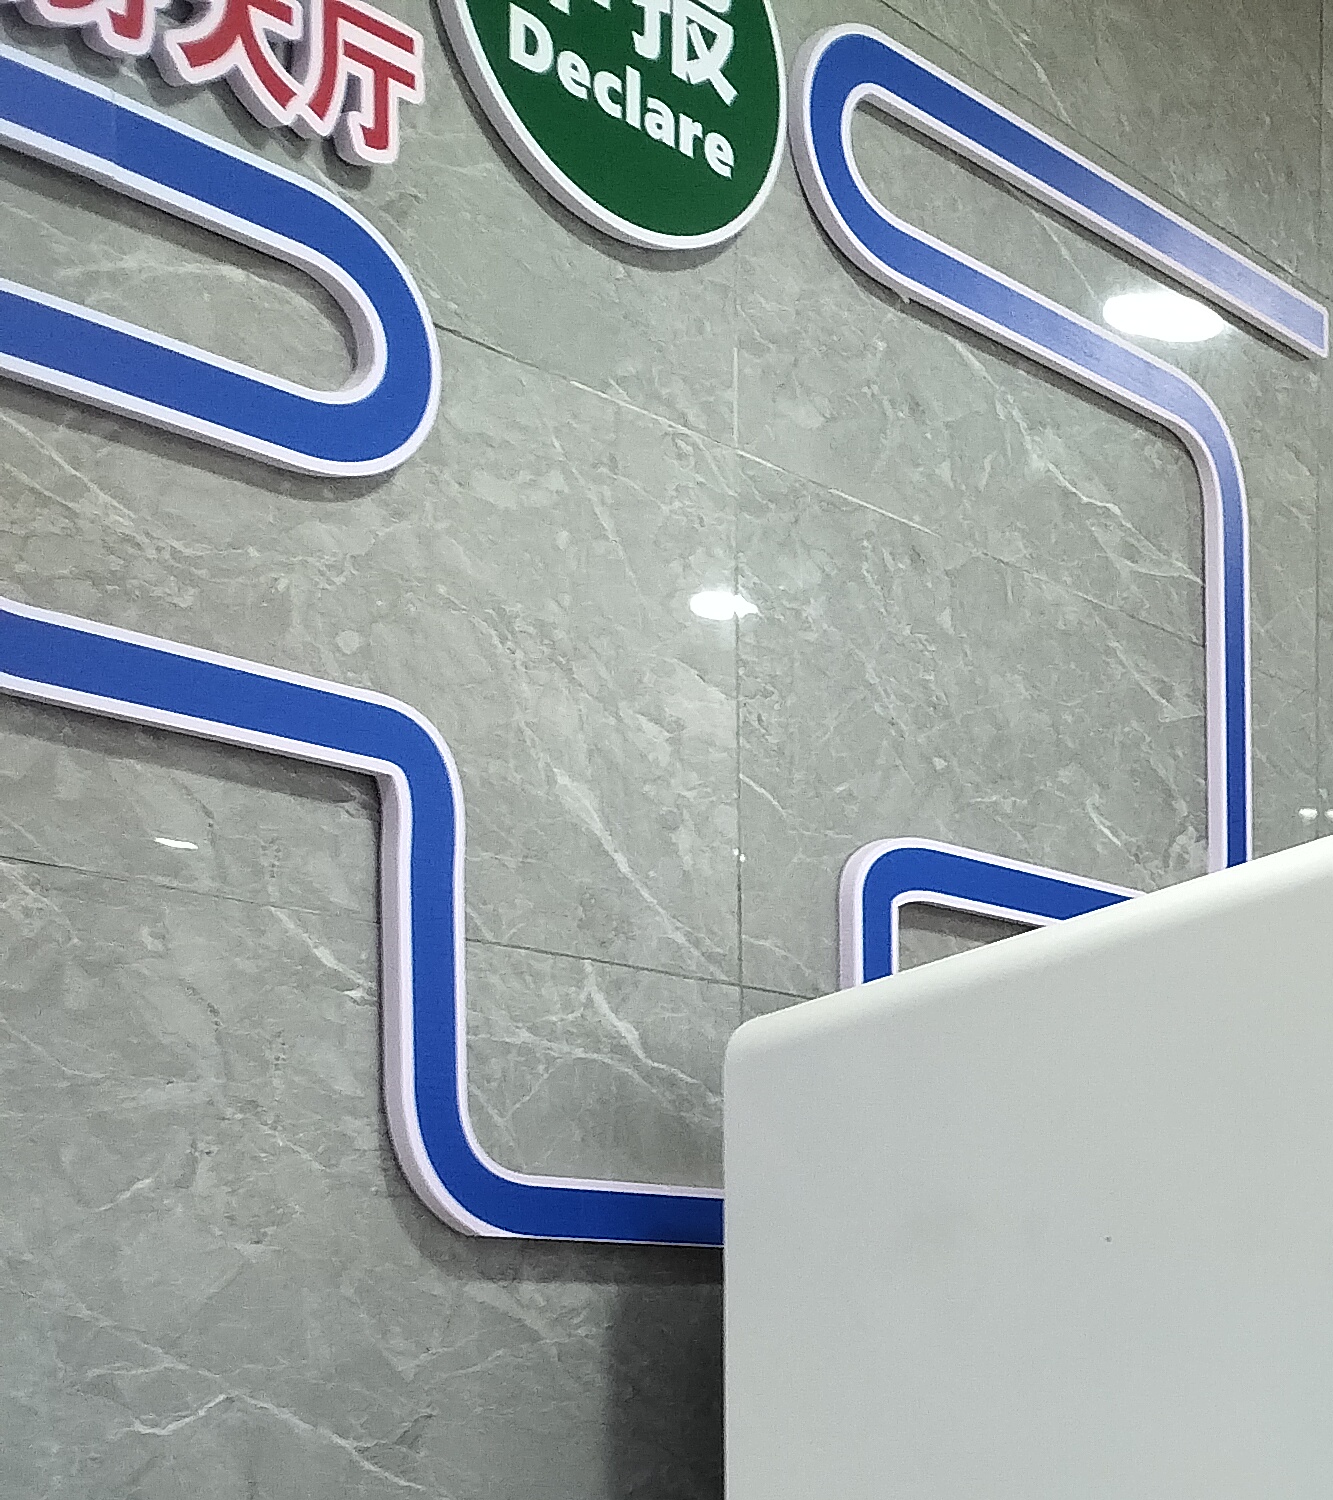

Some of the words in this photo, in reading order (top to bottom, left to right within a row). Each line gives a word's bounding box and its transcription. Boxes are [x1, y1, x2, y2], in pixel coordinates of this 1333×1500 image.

[28, 0, 418, 154] 大厅
[509, 2, 735, 179] Declare
[549, 0, 738, 107] 报
